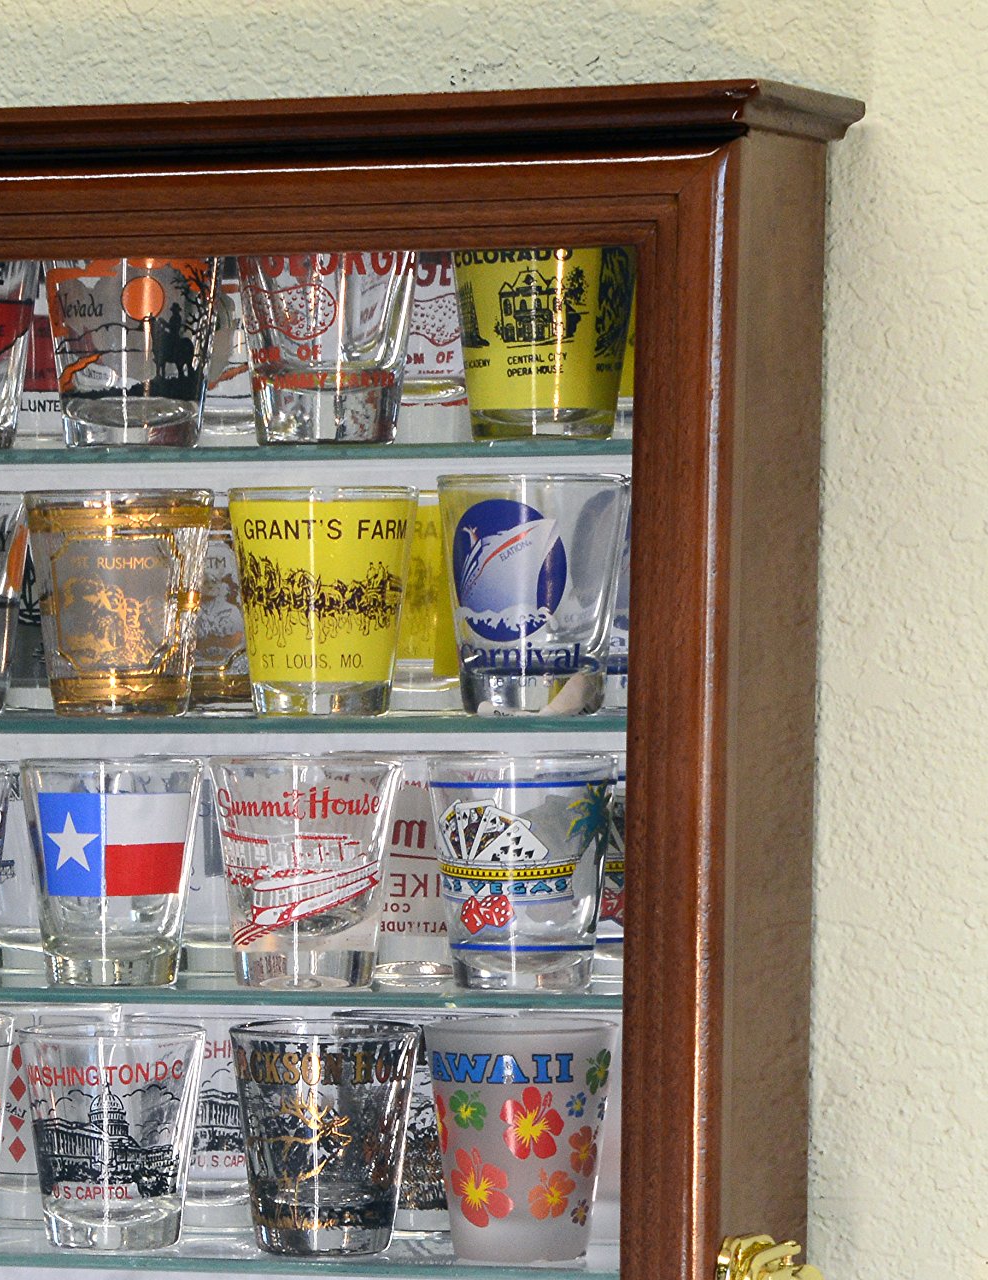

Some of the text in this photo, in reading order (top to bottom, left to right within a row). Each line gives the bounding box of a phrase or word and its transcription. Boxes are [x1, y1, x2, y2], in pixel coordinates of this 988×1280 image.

[58, 290, 104, 319] Nevada
[507, 355, 546, 365] CENTRAL
[507, 367, 534, 377] OPERA
[244, 518, 343, 541] GRANT'S
[357, 518, 408, 541] FARM
[340, 653, 365, 669] MO.
[308, 786, 380, 820] House
[467, 877, 568, 895] VEGAS
[76, 1186, 133, 1201] CAPITOL
